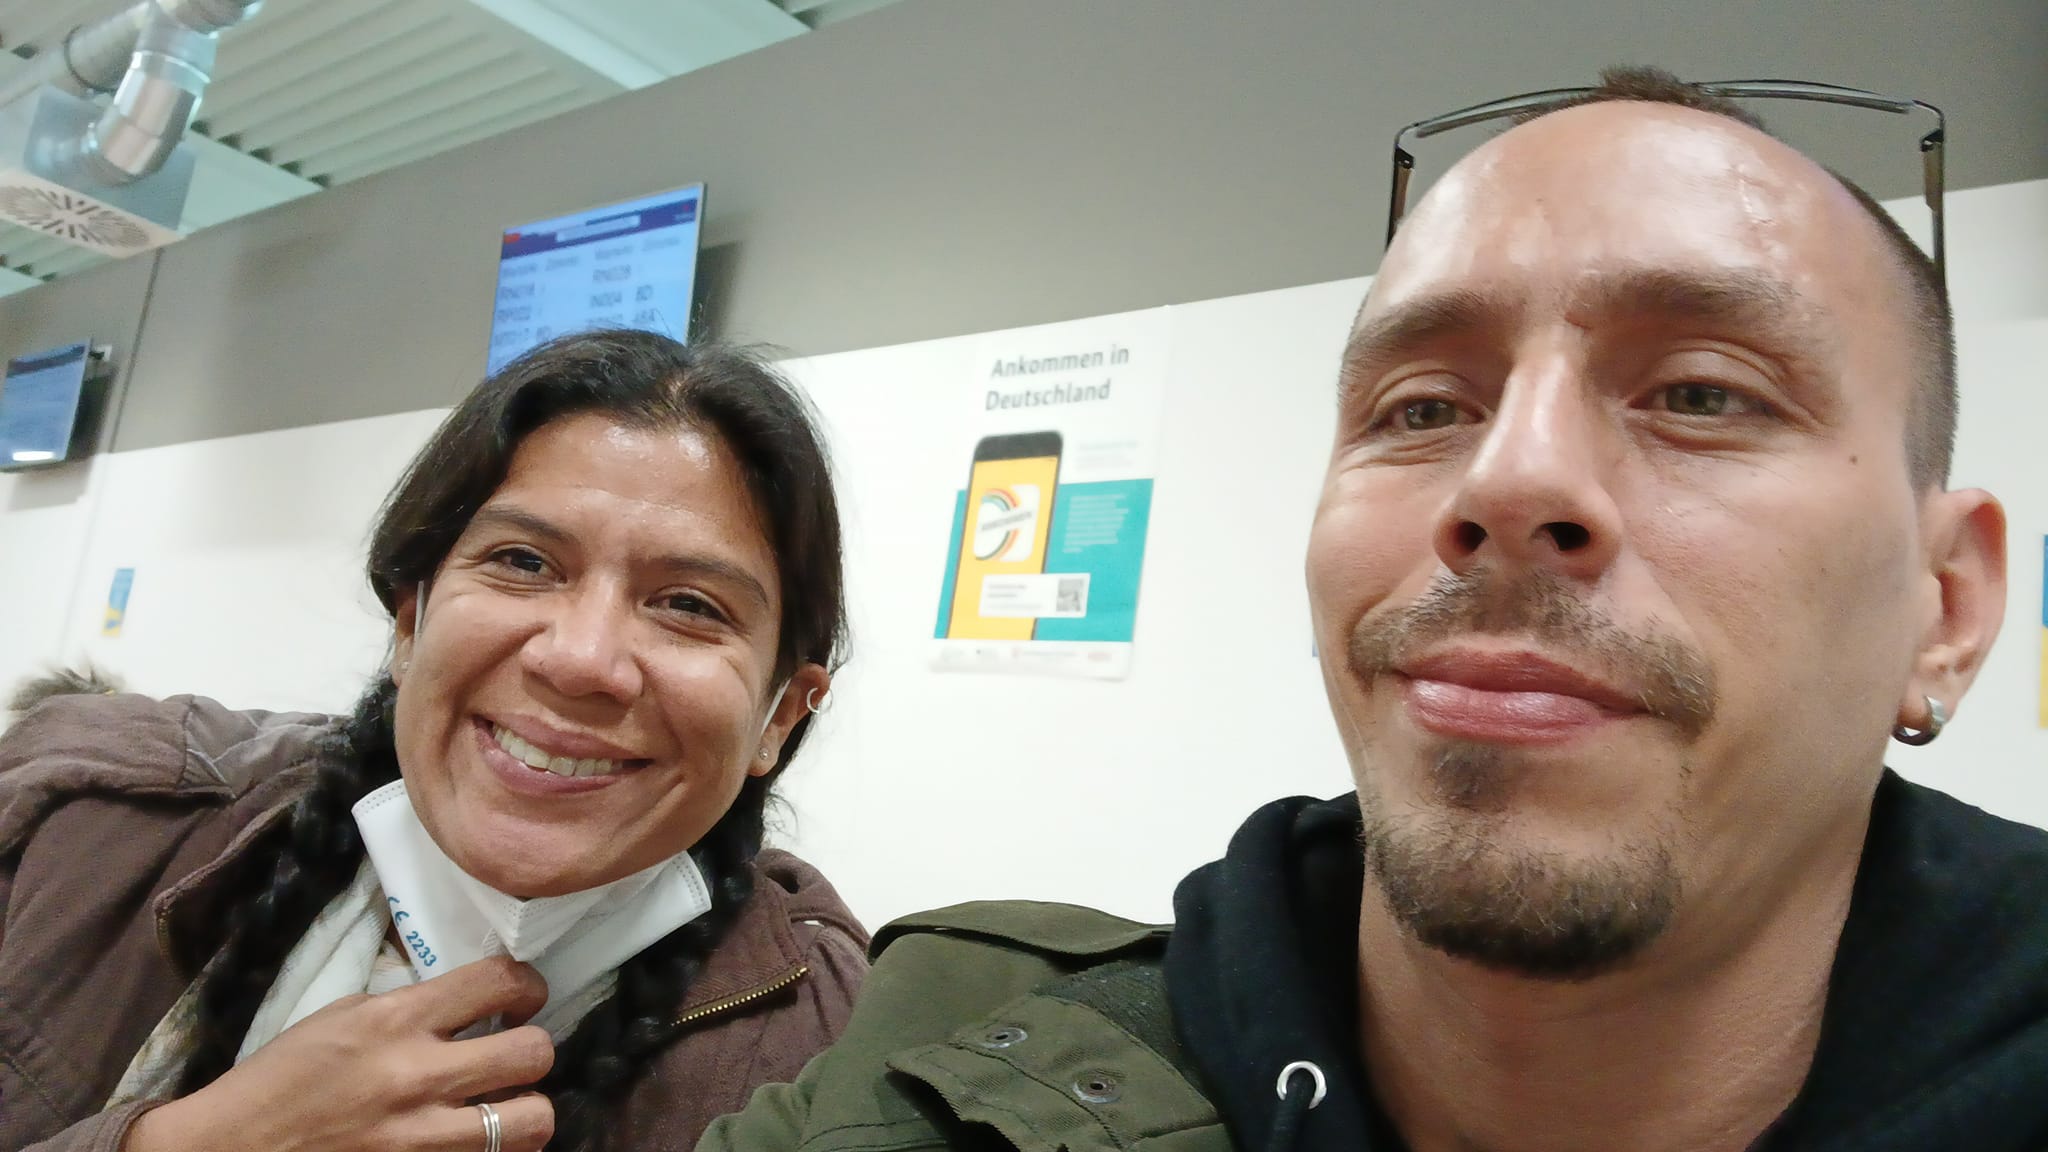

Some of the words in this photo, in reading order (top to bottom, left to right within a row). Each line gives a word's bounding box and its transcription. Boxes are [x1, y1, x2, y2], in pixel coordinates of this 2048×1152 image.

[991, 355, 1104, 378] Ankommen
[1110, 343, 1130, 366] in
[985, 378, 1112, 411] Deutschland
[406, 930, 437, 967] 2233
